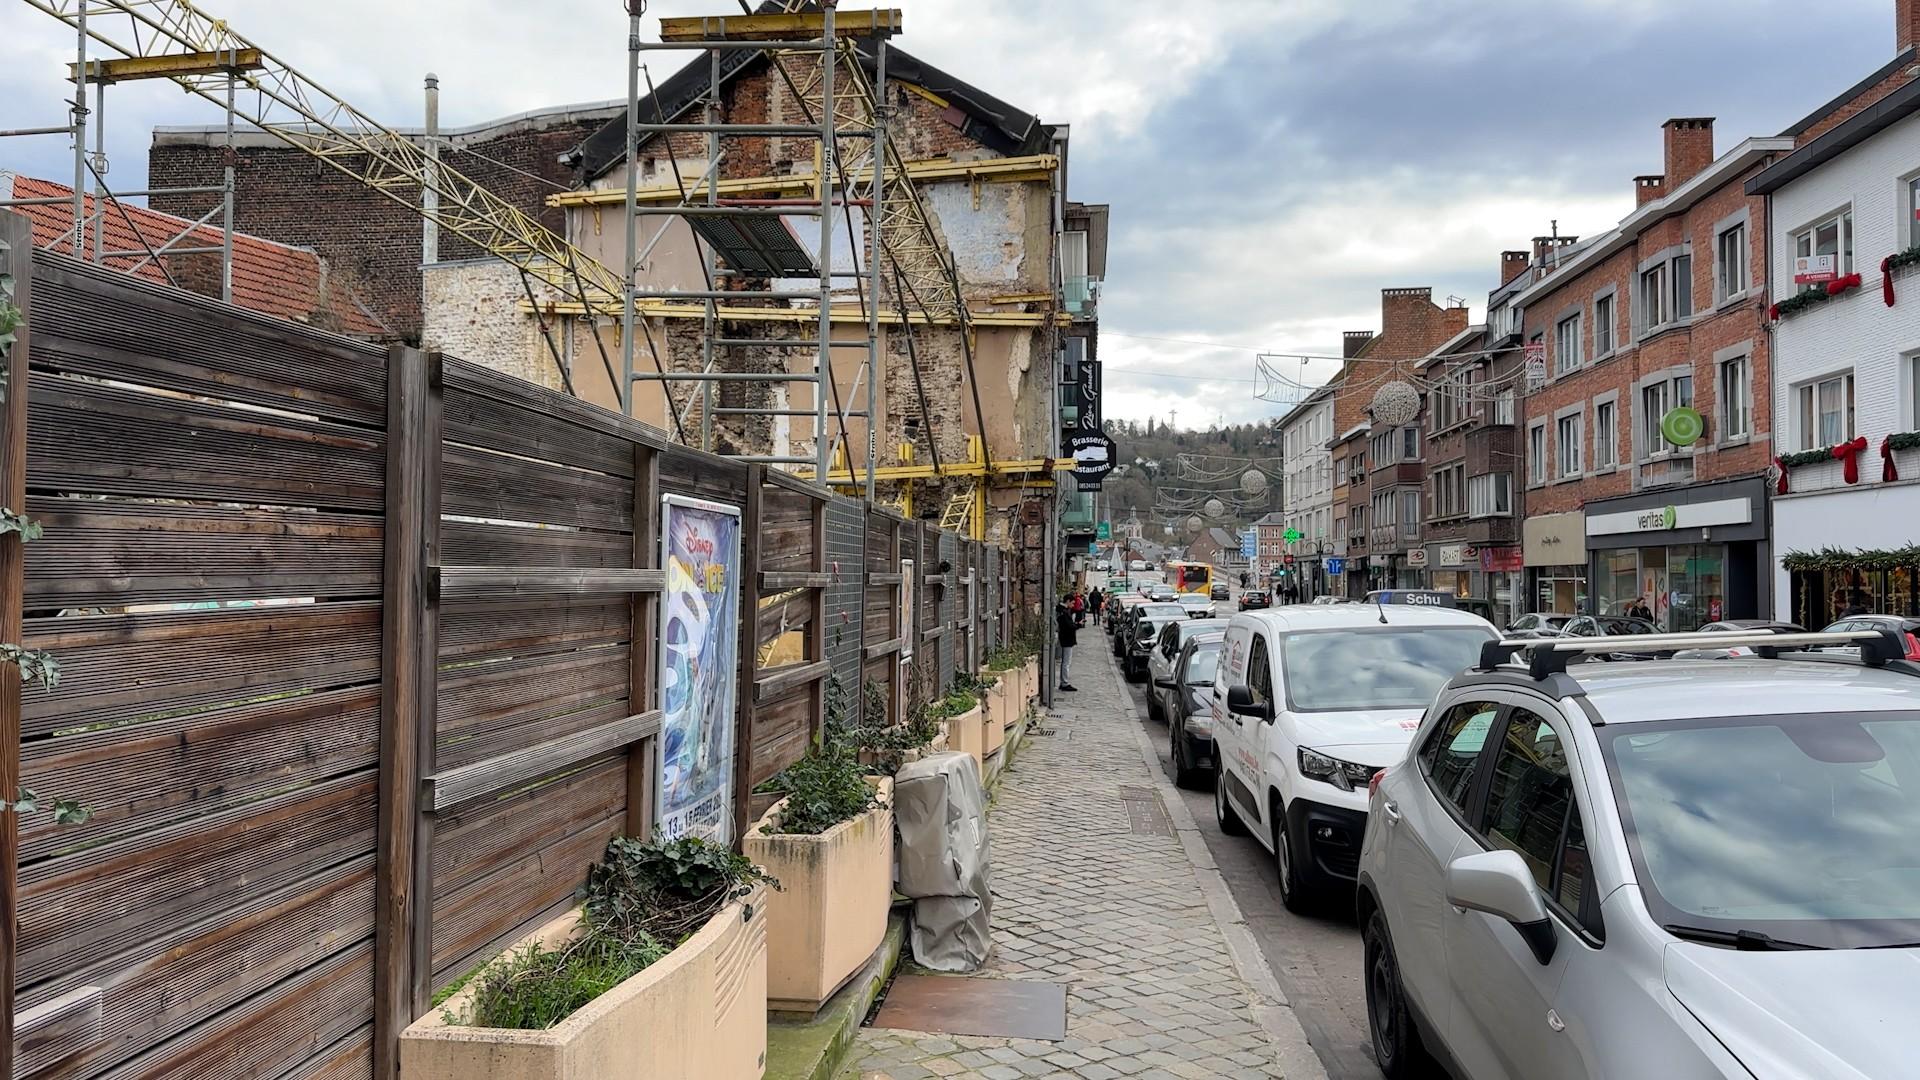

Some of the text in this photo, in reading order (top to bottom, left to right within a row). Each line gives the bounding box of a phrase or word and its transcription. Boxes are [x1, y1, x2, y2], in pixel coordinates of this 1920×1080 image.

[1081, 403, 1095, 430] Rive
[1071, 436, 1109, 447] Brasserie
[1637, 511, 1664, 529] veritas
[1406, 593, 1441, 605] Schu
[668, 816, 678, 836] 13
